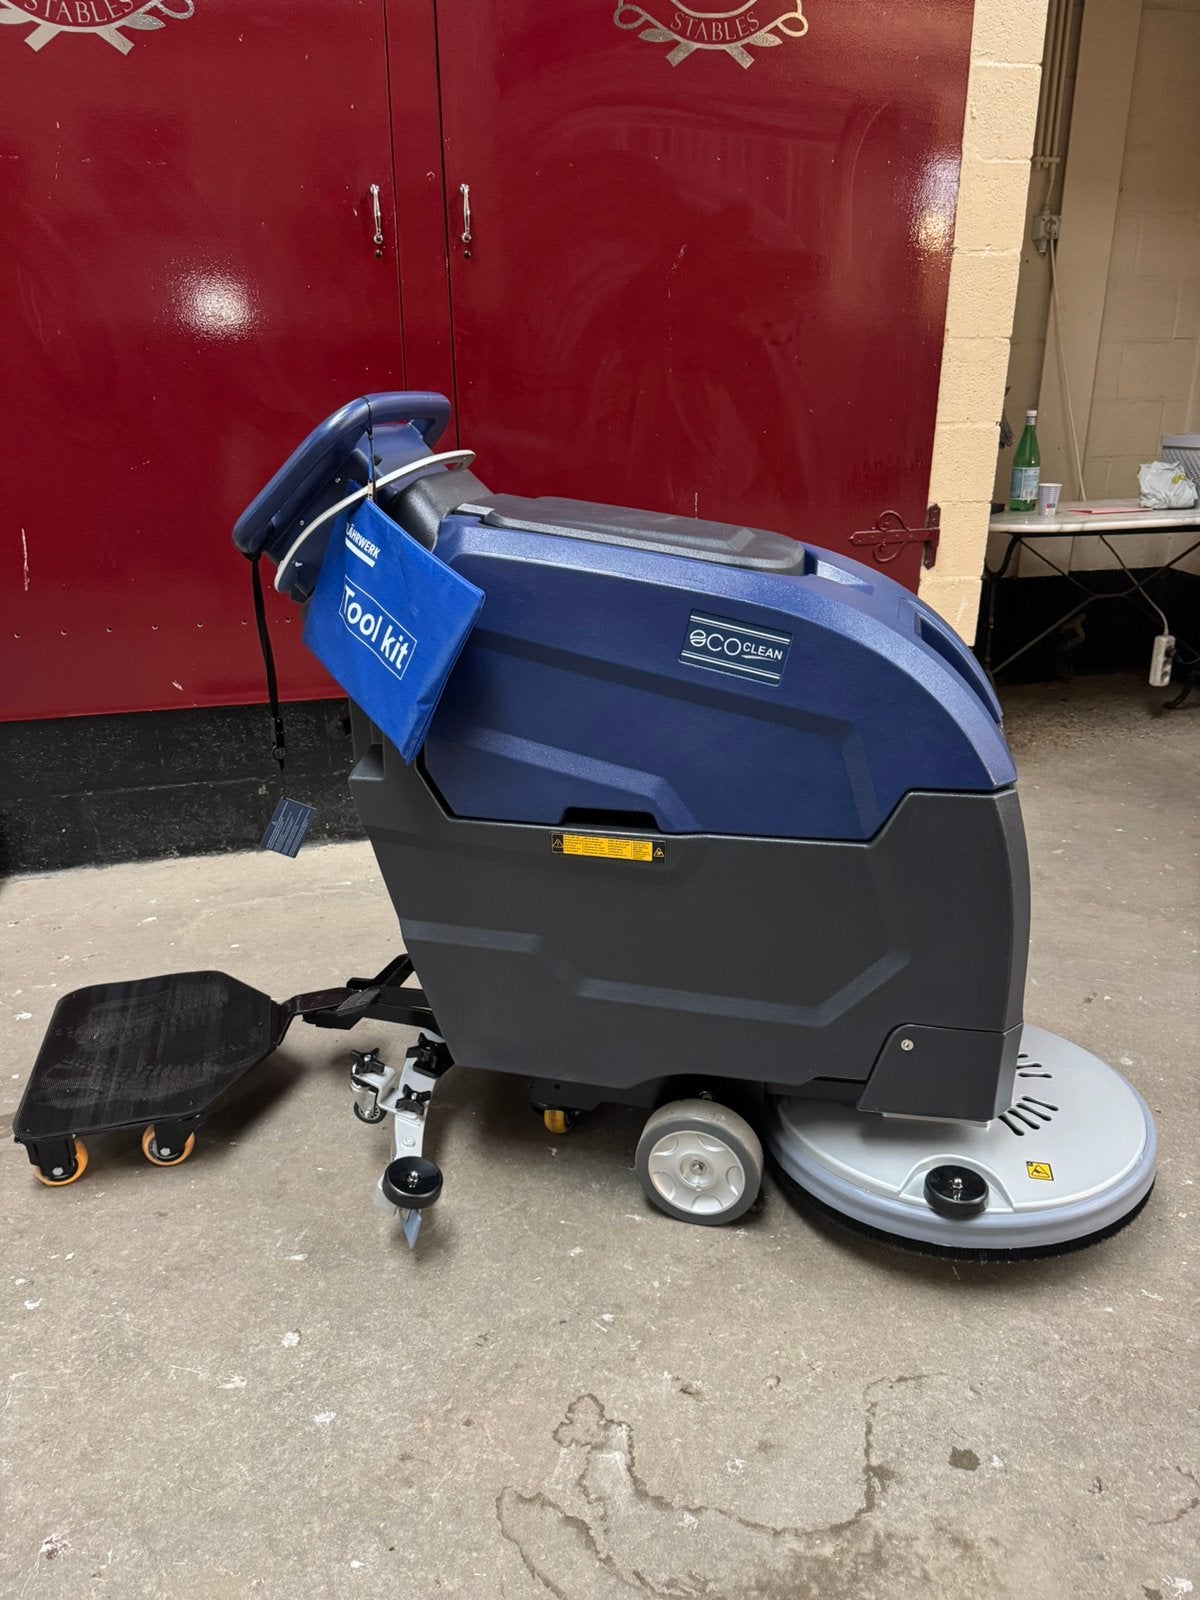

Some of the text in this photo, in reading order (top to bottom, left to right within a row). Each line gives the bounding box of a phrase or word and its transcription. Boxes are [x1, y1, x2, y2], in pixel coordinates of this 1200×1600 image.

[671, 11, 760, 41] STABLES
[344, 584, 409, 670] Tool kit
[743, 642, 783, 660] CLEAN
